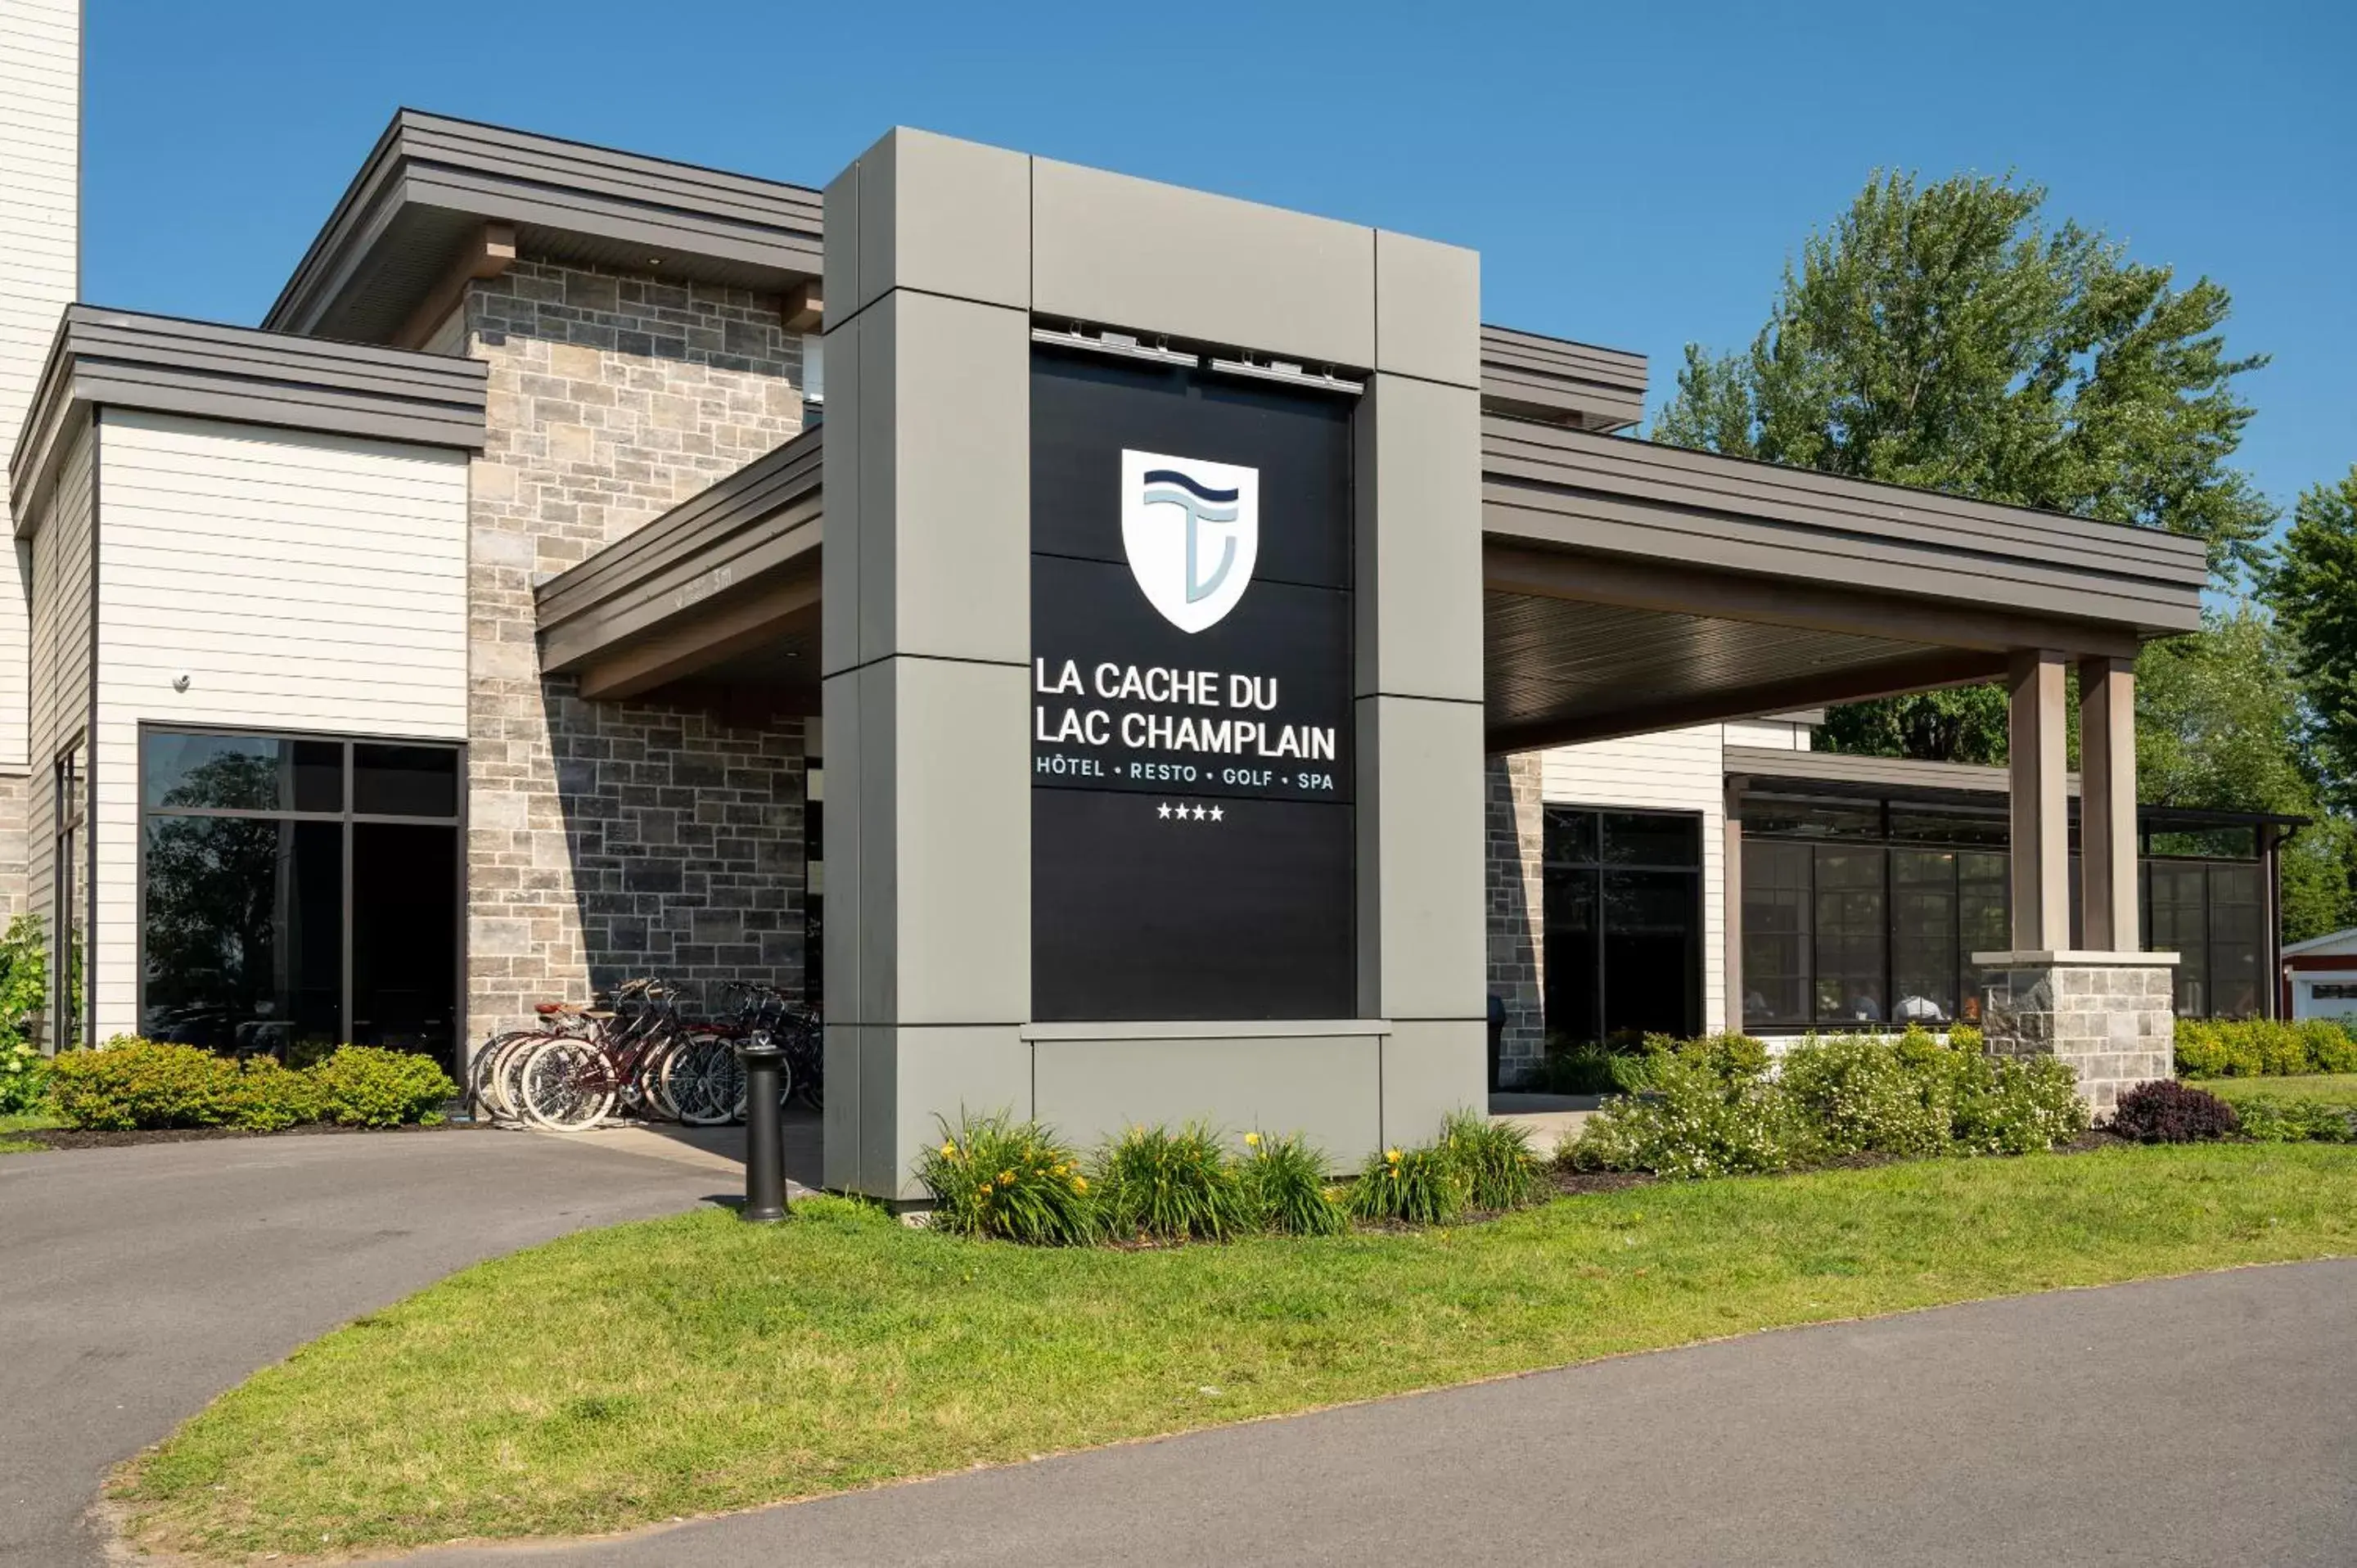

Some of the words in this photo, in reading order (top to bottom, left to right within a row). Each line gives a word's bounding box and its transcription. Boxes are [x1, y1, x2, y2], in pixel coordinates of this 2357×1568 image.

[1035, 656, 1085, 696] LA
[1094, 662, 1220, 706] CACHE
[1229, 674, 1278, 711] DU
[1035, 705, 1111, 746] LAC
[1121, 712, 1336, 761] CHAMPLAIN
[1036, 753, 1105, 777] HÔTEL
[1129, 762, 1197, 782] RESTO
[1223, 768, 1273, 787] GOLF
[1298, 773, 1333, 791] SPA
